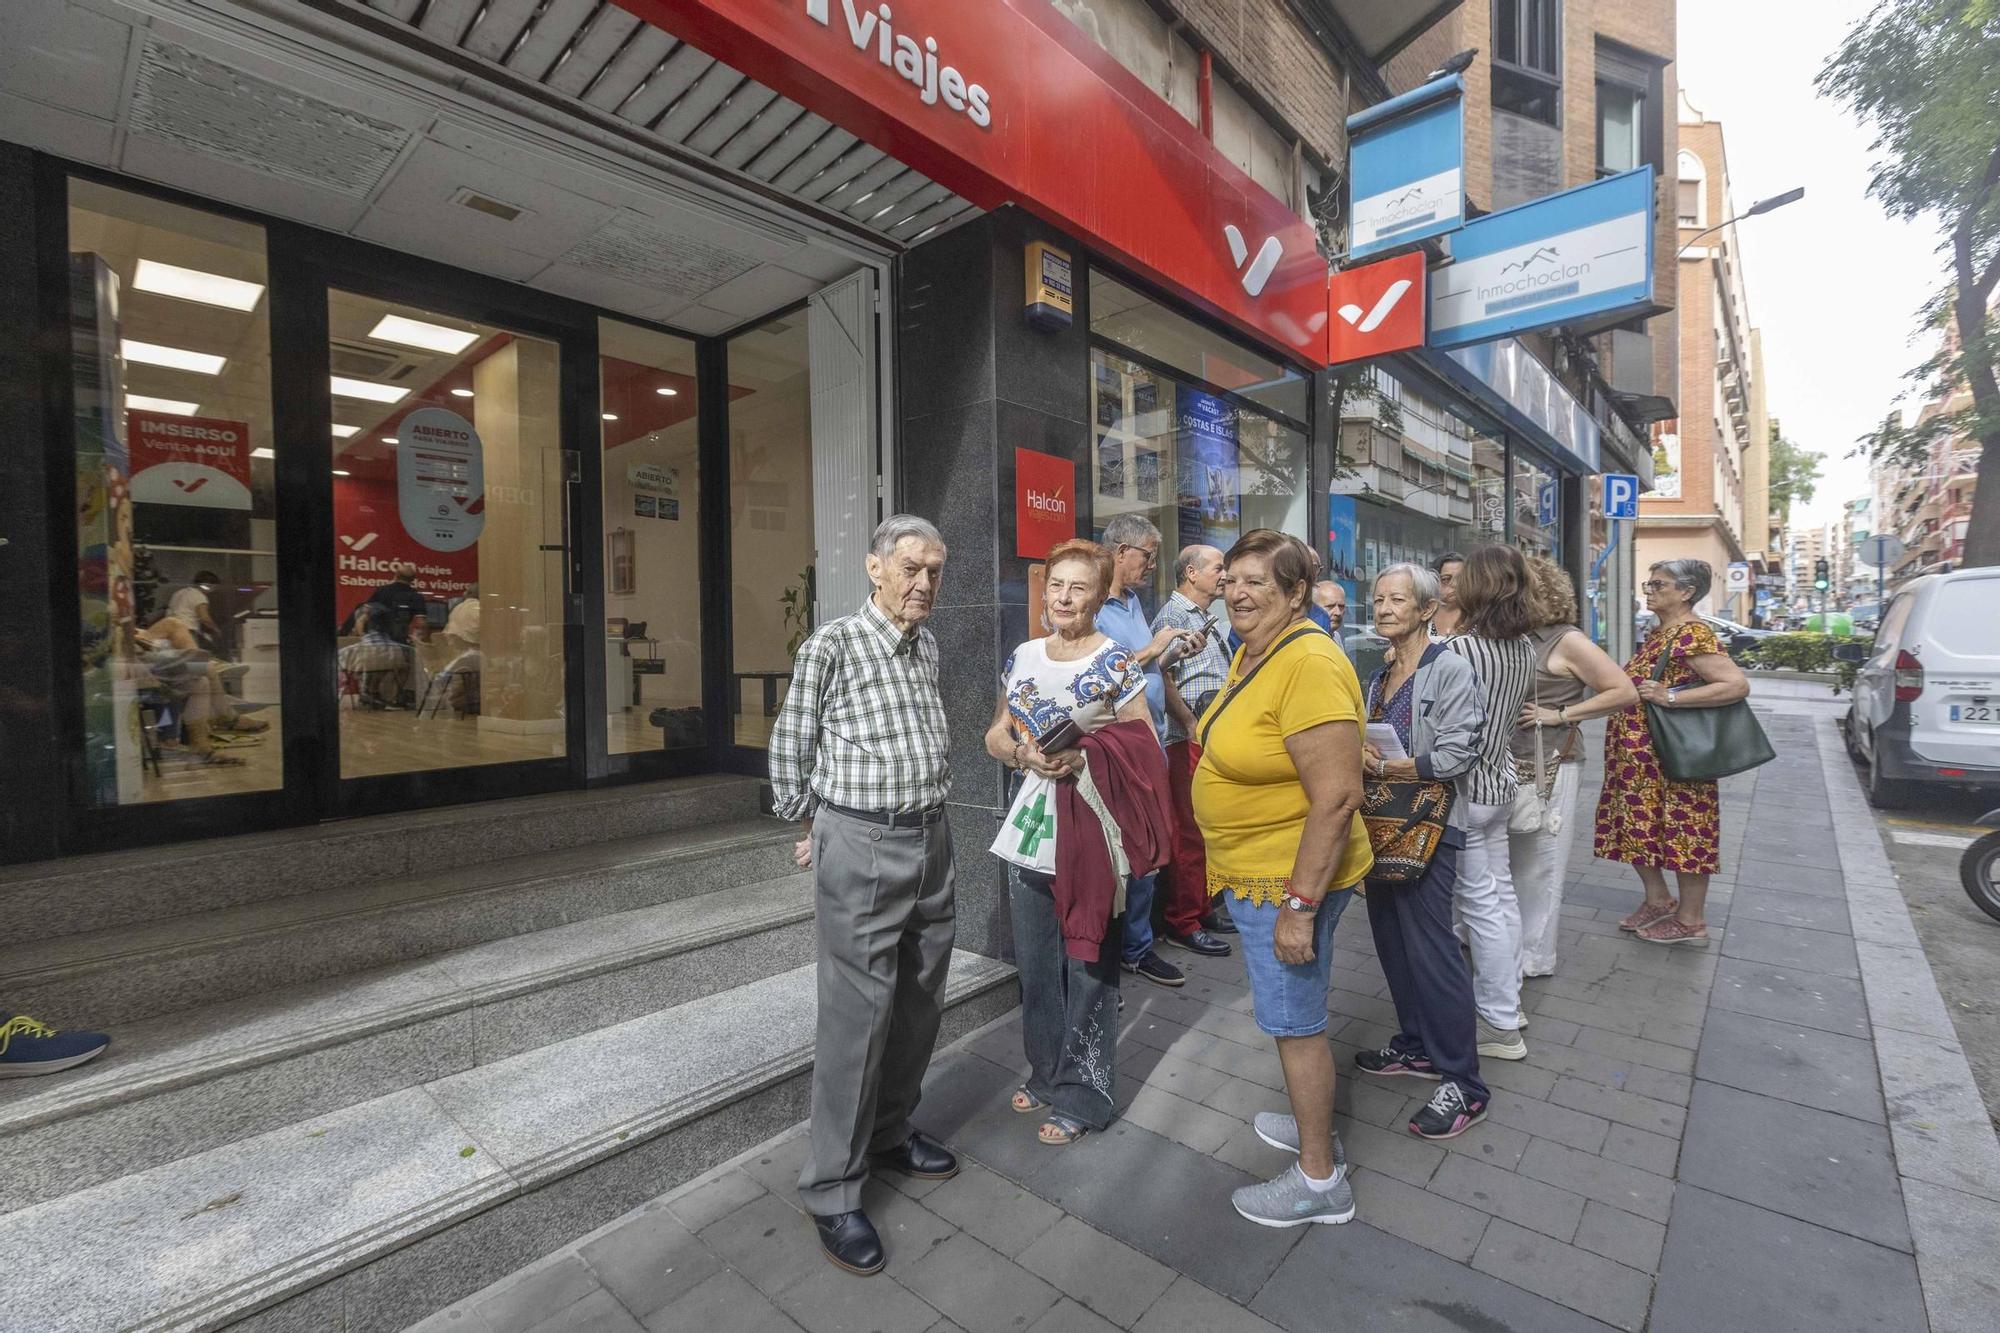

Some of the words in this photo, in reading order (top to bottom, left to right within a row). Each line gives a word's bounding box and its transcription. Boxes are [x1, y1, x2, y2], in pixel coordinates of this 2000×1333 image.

[842, 0, 991, 127] viajes
[1368, 197, 1444, 228] Inmochoclan
[1477, 263, 1591, 301] Inmochoclan
[141, 420, 238, 442] IMSERSO
[412, 424, 470, 441] ABIERTO
[1183, 414, 1210, 431] COSTAS
[1210, 423, 1215, 433] E
[1215, 424, 1233, 438] ISLAS
[142, 438, 191, 453] Venta
[636, 471, 671, 484] ABIERTO
[1027, 486, 1066, 514] Halcón
[1611, 479, 1632, 513] P
[418, 564, 452, 576] viajes
[430, 579, 472, 592] viajero
